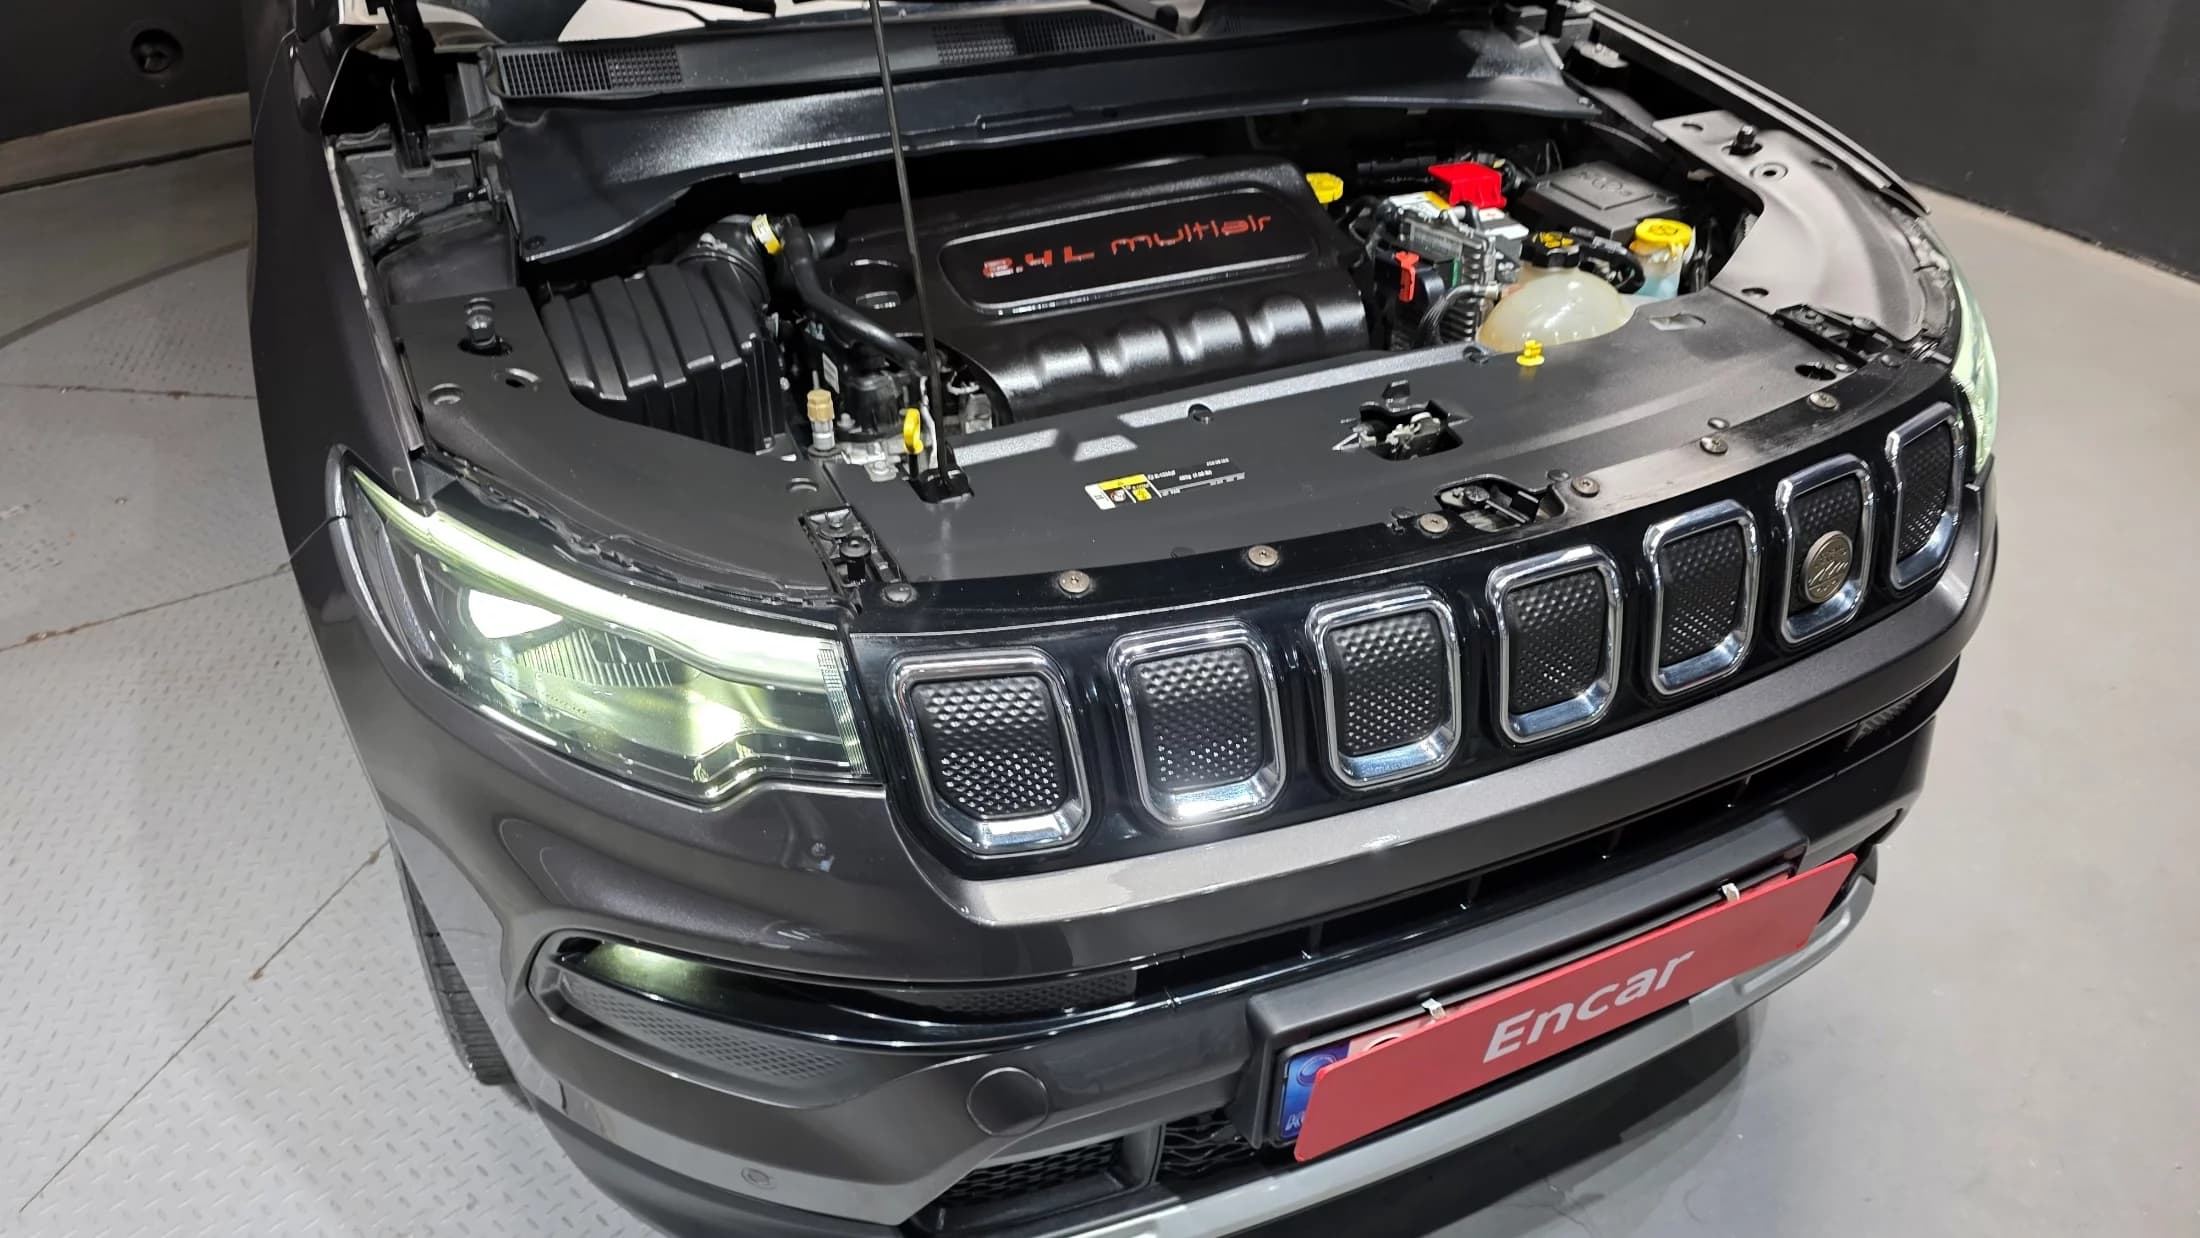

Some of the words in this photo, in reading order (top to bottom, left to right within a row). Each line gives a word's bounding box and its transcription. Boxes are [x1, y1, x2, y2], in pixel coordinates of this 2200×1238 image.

[982, 249, 1053, 279] 2.4
[1063, 246, 1095, 264] L
[1110, 215, 1272, 256] multiair
[1482, 950, 1695, 1064] Encar
